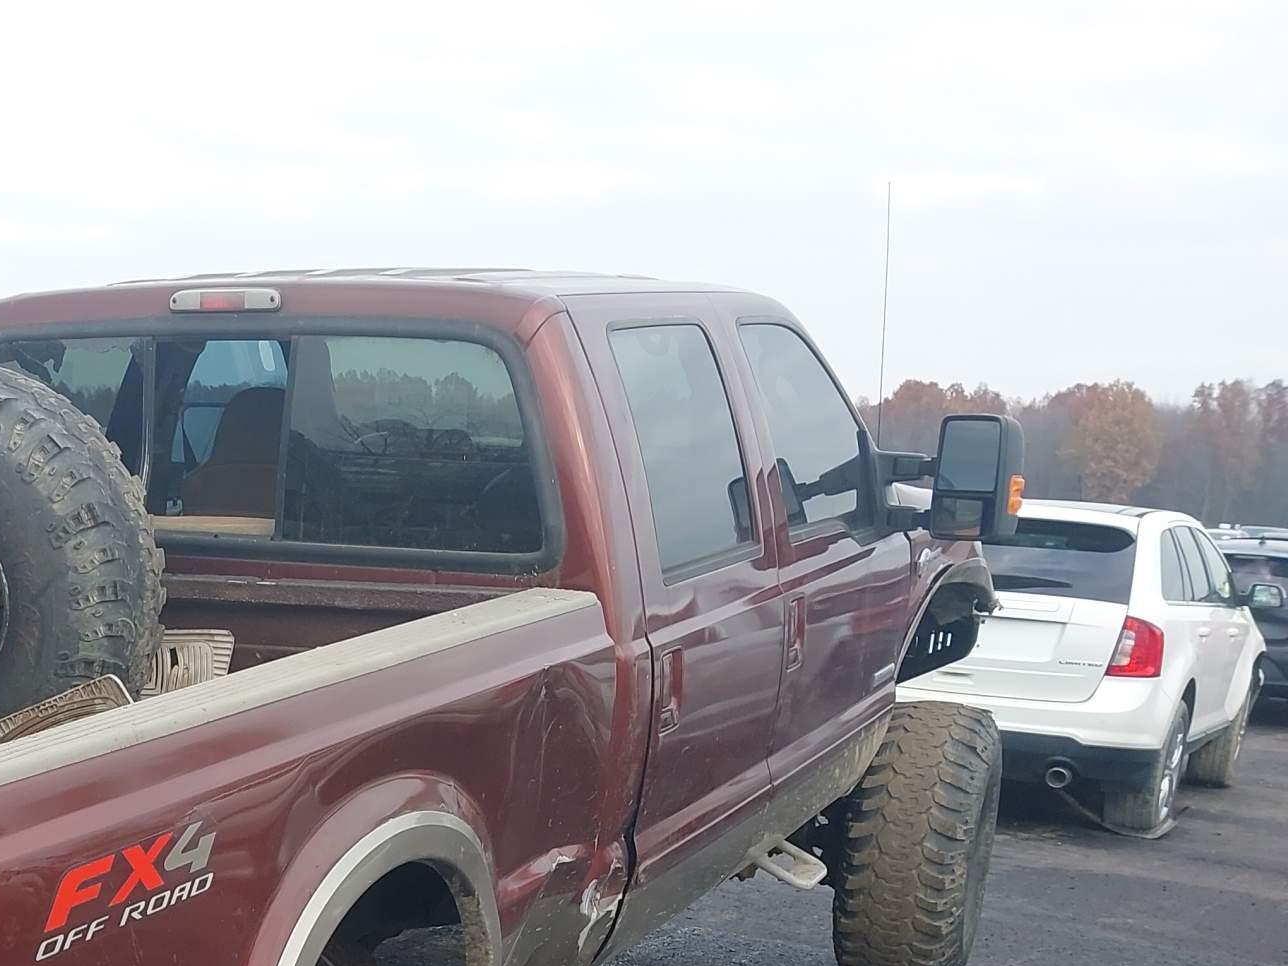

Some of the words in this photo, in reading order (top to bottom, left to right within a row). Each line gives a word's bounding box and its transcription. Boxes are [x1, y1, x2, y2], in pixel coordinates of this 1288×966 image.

[34, 914, 111, 963] OFF
[119, 871, 216, 928] ROAD
[43, 820, 217, 933] FX4
